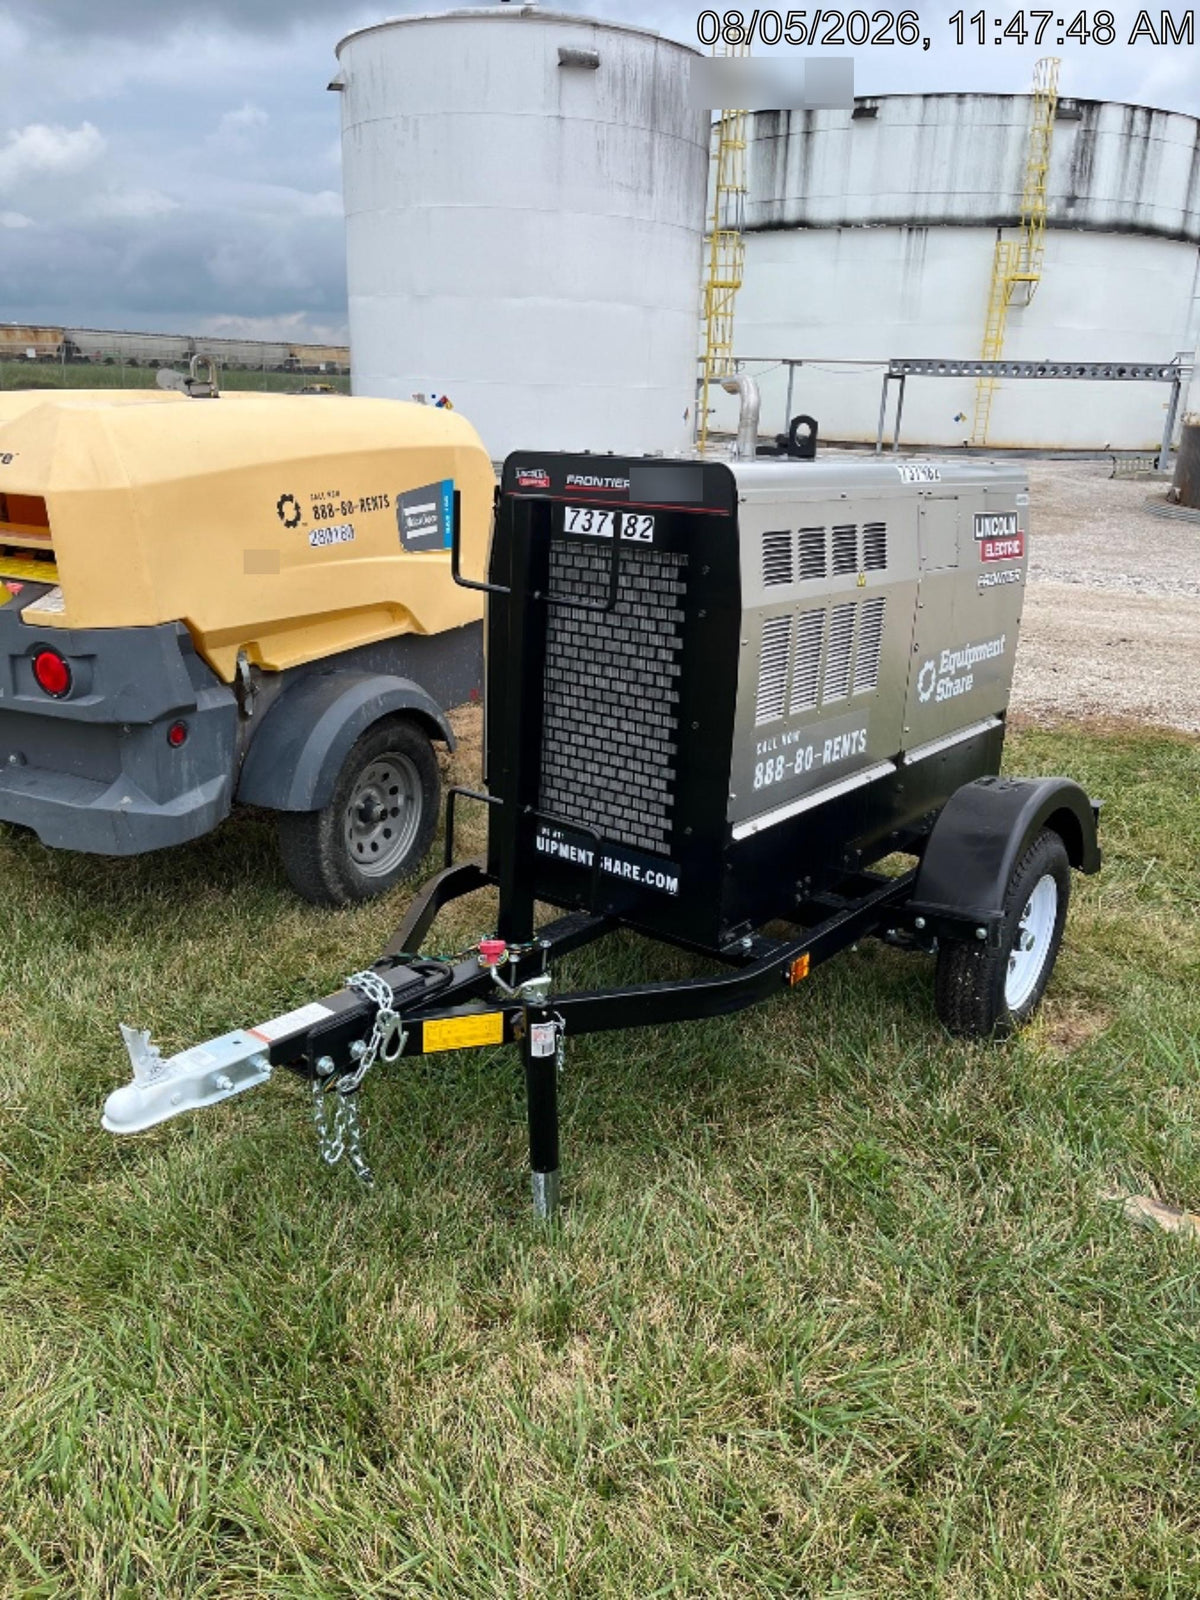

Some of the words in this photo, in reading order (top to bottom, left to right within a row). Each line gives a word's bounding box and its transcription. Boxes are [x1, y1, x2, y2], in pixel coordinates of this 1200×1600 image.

[568, 509, 654, 539] 73782
[975, 516, 1016, 538] LINCOLN
[938, 634, 1006, 675] Equipment
[935, 674, 974, 703] Share
[753, 728, 867, 791] 888-80-RENTS
